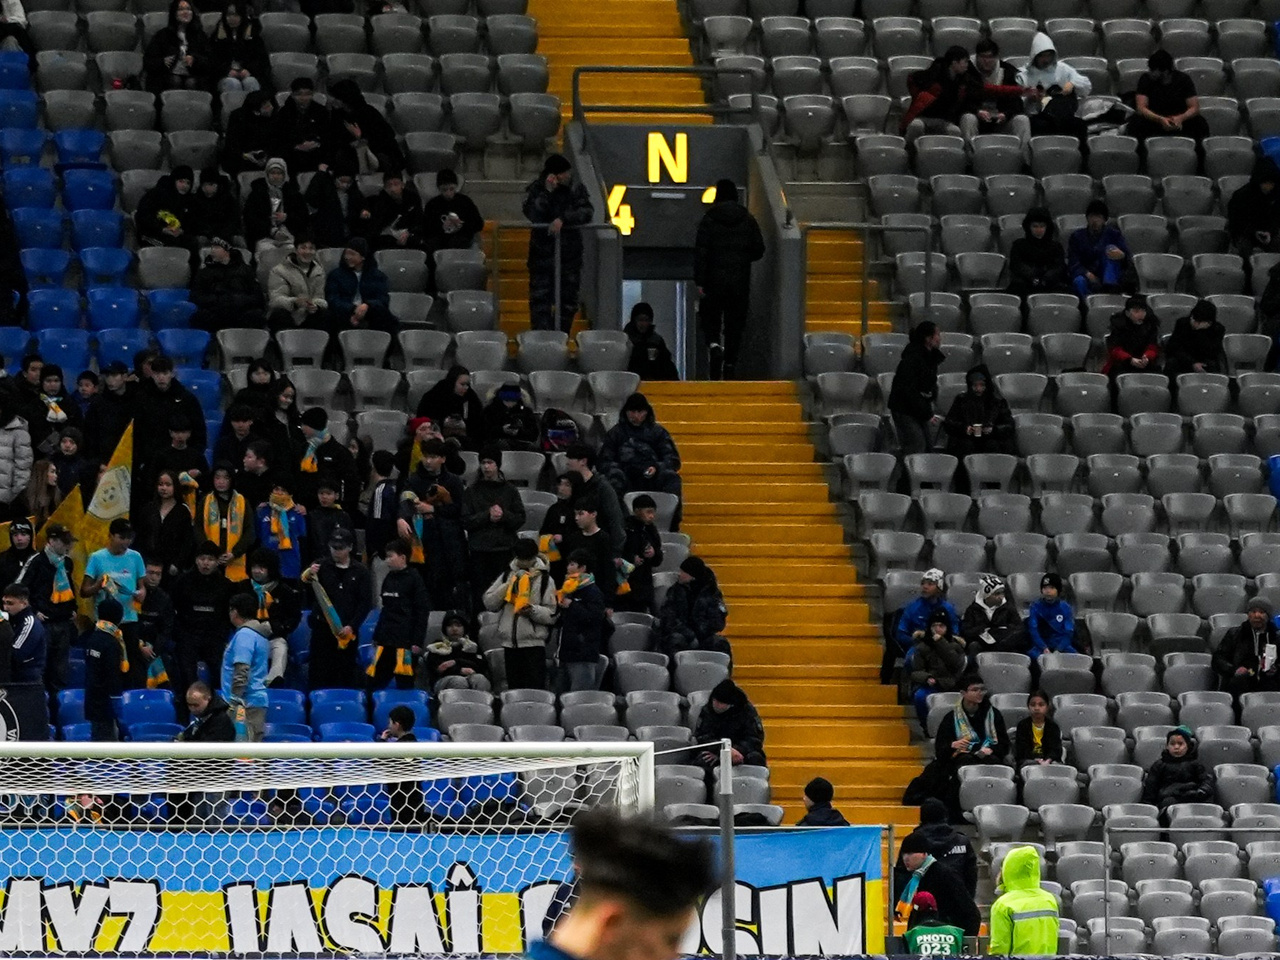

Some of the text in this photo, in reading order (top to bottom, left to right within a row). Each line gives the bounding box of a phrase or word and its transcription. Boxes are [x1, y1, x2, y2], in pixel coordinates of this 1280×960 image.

[646, 131, 689, 184] N
[608, 184, 635, 236] 4
[916, 934, 955, 945] PHOTO
[920, 944, 952, 956] 023
